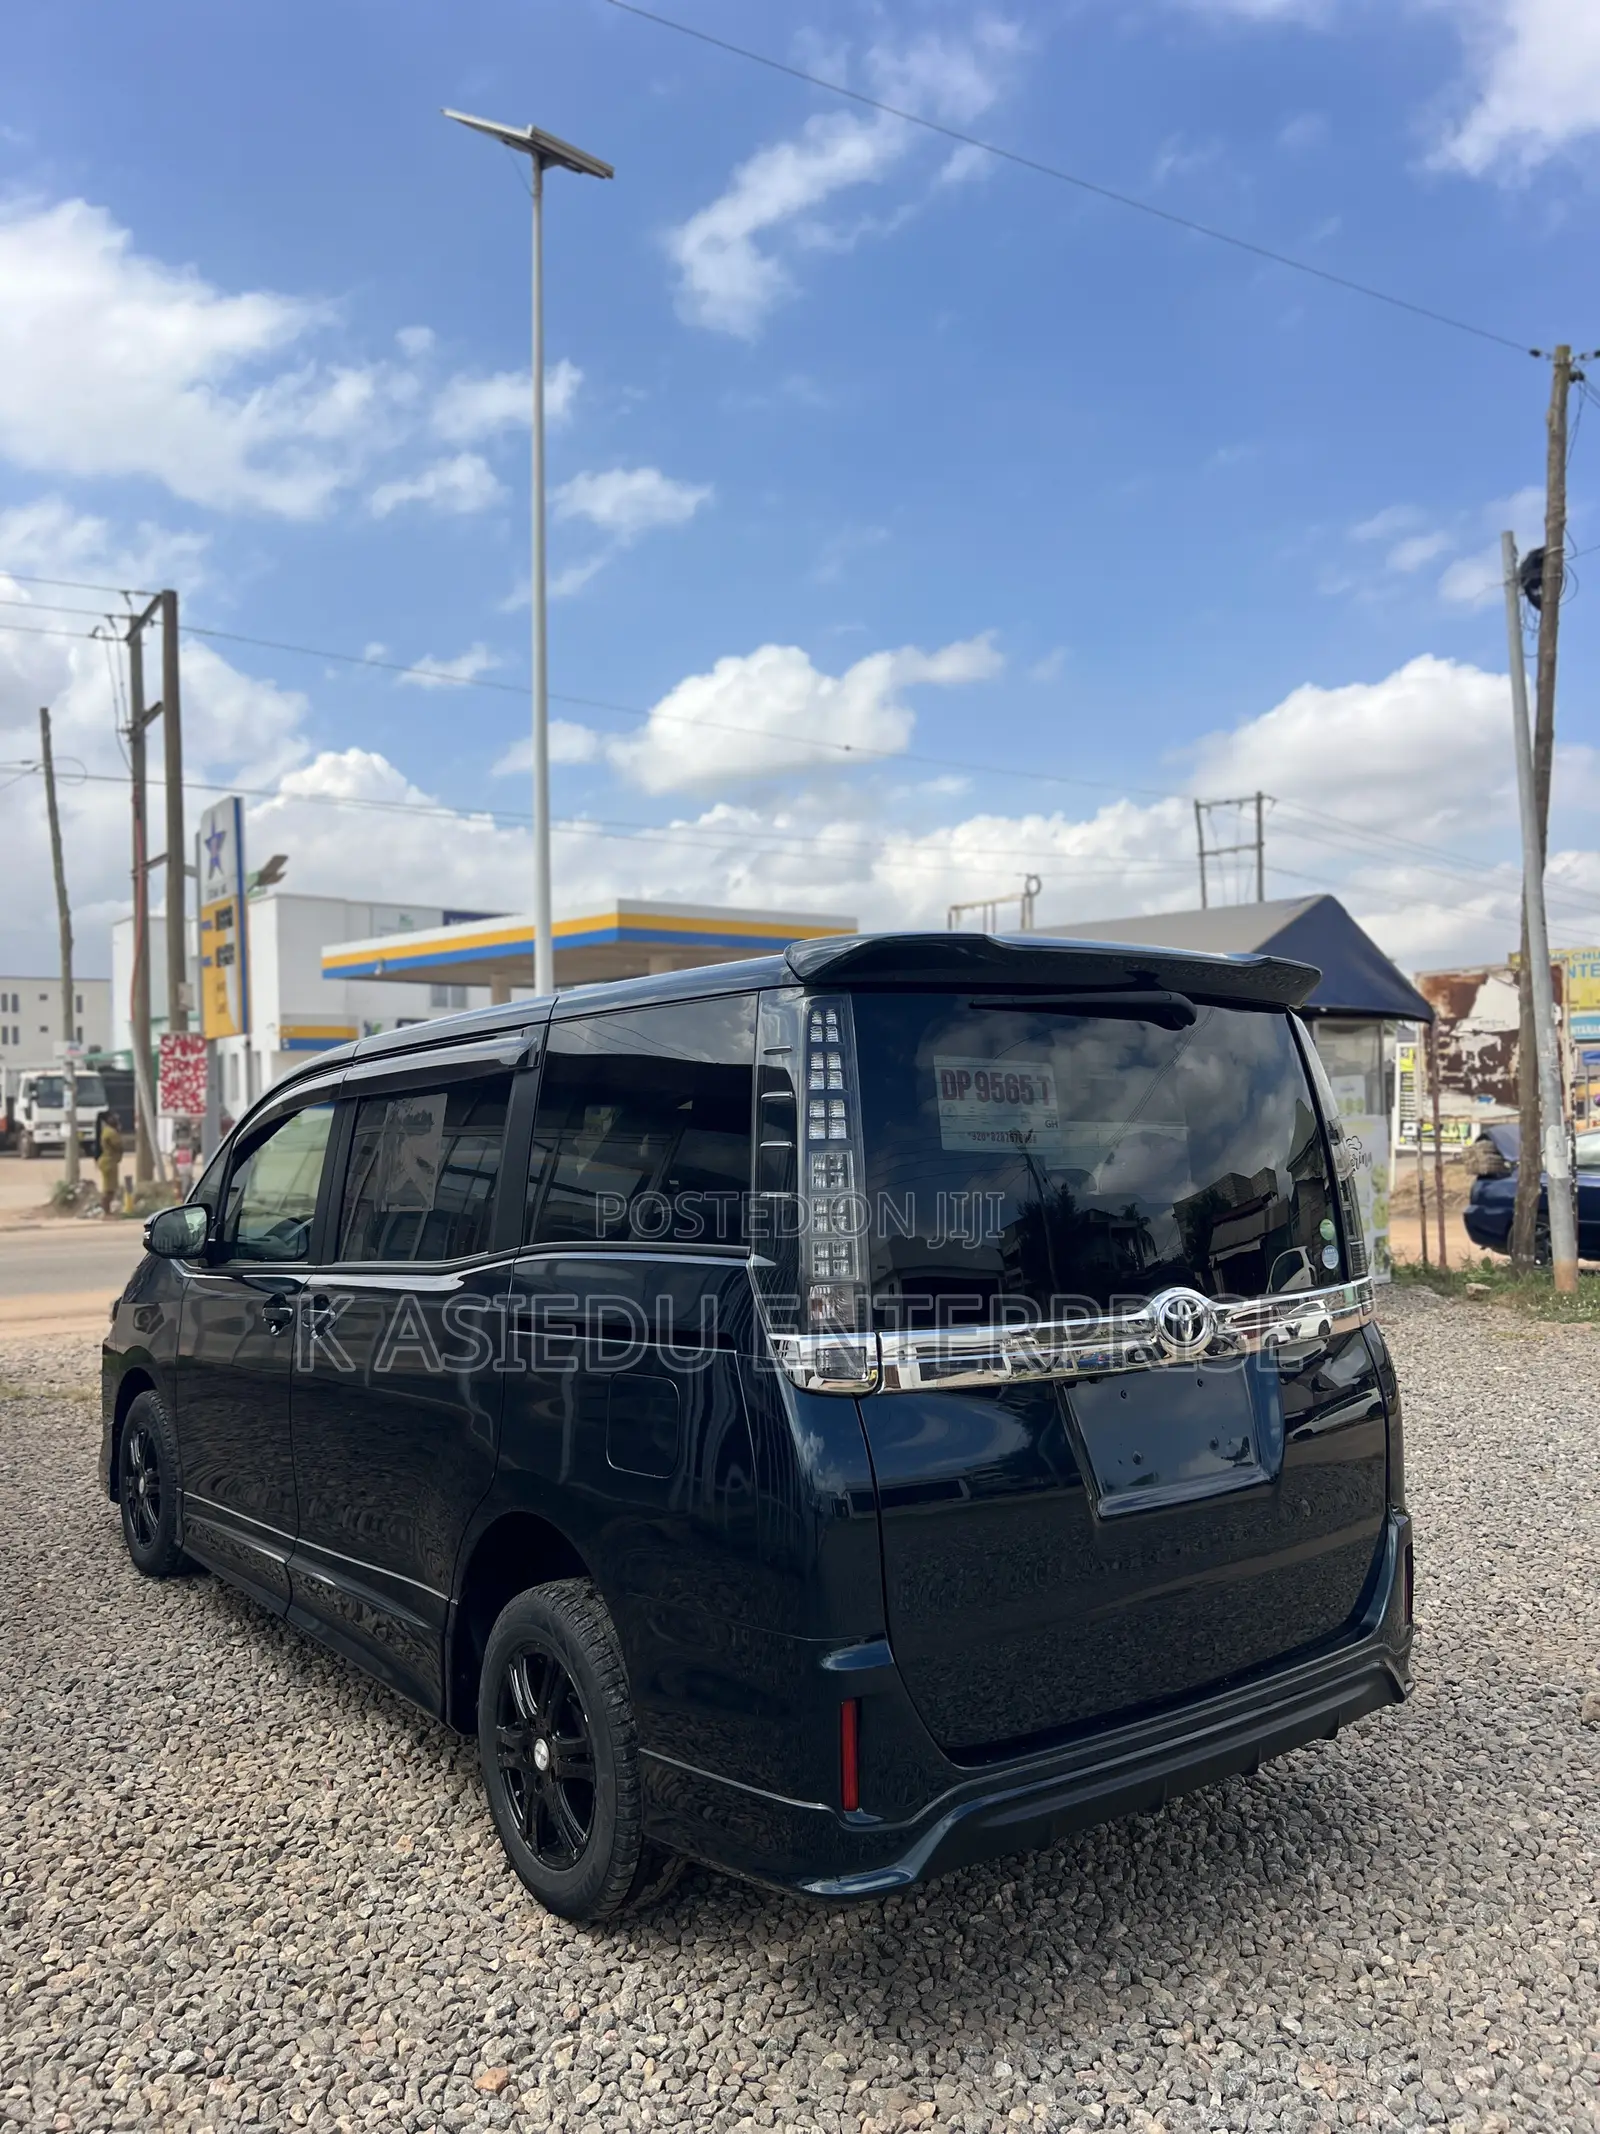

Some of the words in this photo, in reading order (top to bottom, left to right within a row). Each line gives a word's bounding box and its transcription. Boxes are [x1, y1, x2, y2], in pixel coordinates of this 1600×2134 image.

[160, 1033, 207, 1056] SAND
[940, 1068, 972, 1101] DP
[1044, 1119, 1059, 1129] GH
